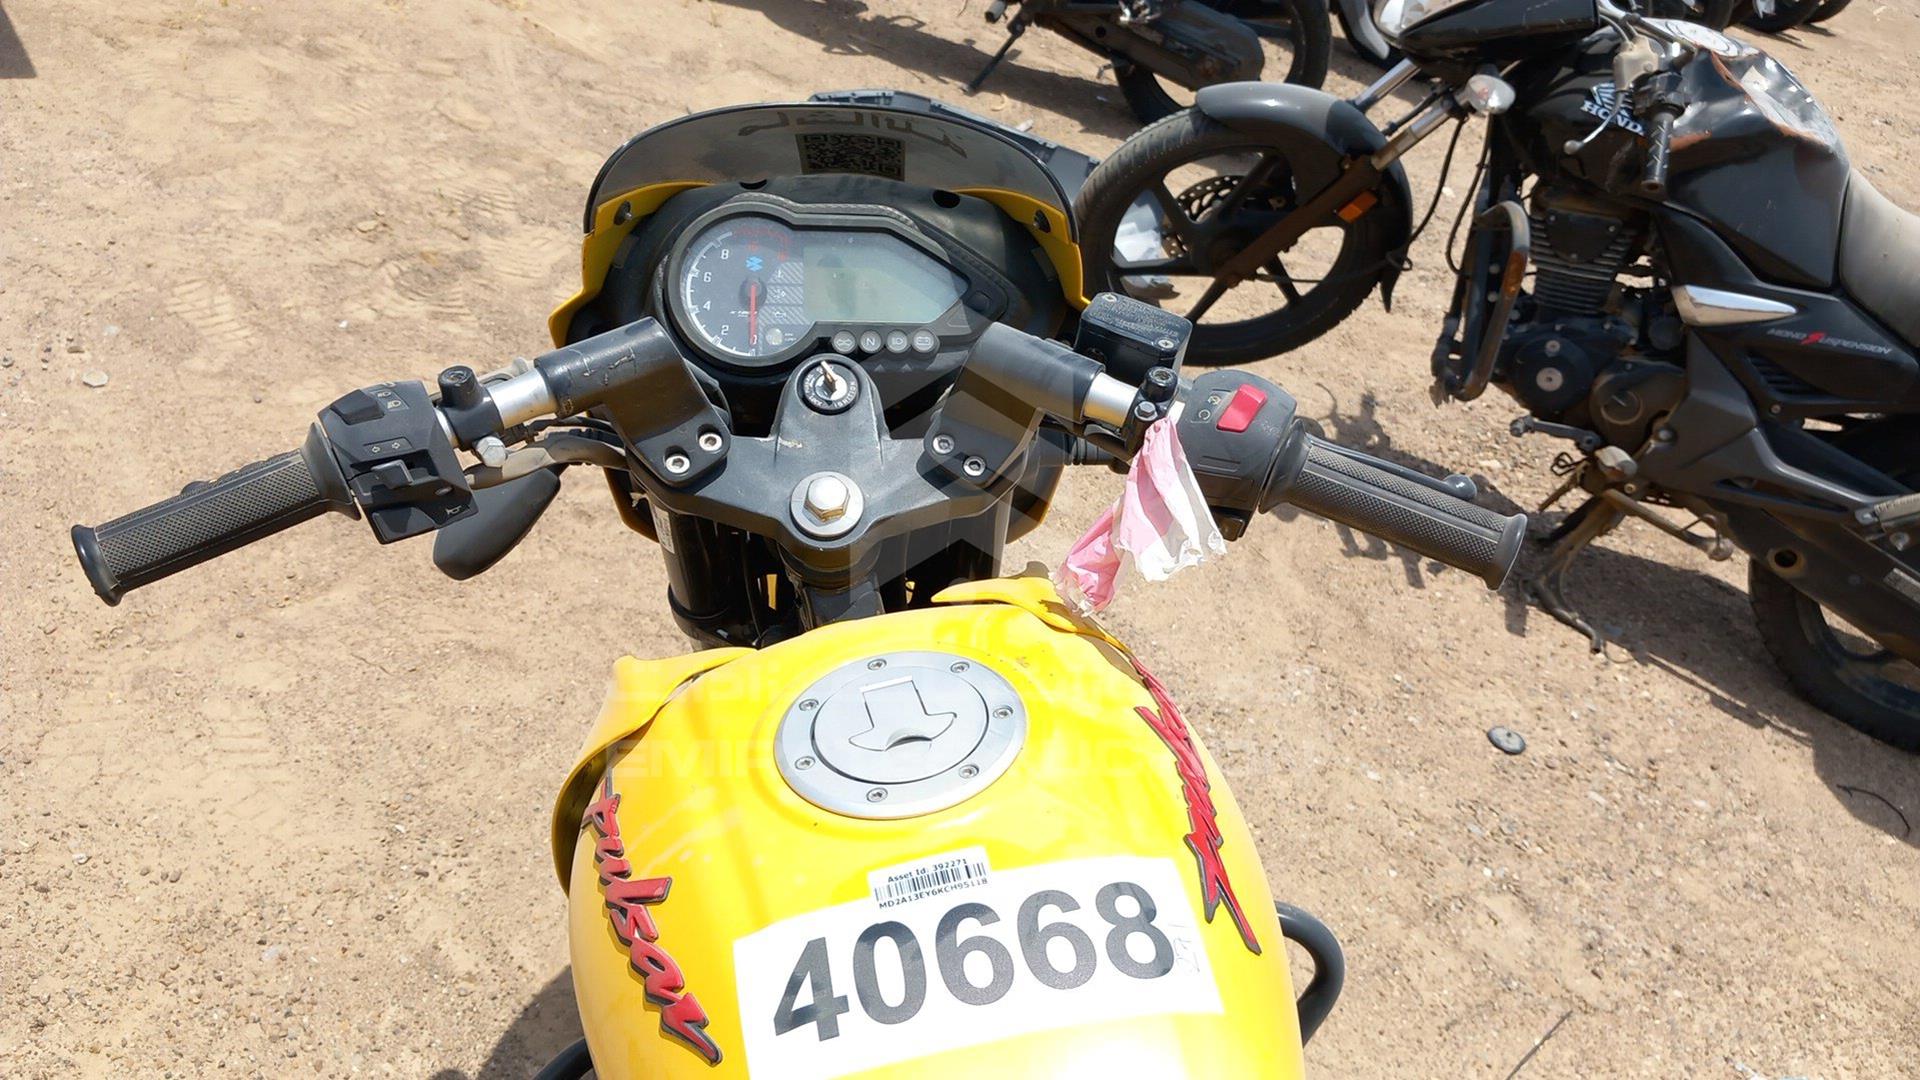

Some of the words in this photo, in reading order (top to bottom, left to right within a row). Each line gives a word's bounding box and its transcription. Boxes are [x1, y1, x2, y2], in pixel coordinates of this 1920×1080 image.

[1580, 100, 1645, 137] HOND
[720, 249, 729, 260] 8
[703, 271, 712, 282] 6
[703, 301, 711, 311] 4
[721, 325, 729, 335] 2
[866, 337, 876, 346] N
[887, 871, 913, 883] Asset
[932, 858, 968, 872] 392271
[773, 881, 1174, 1042] 40668
